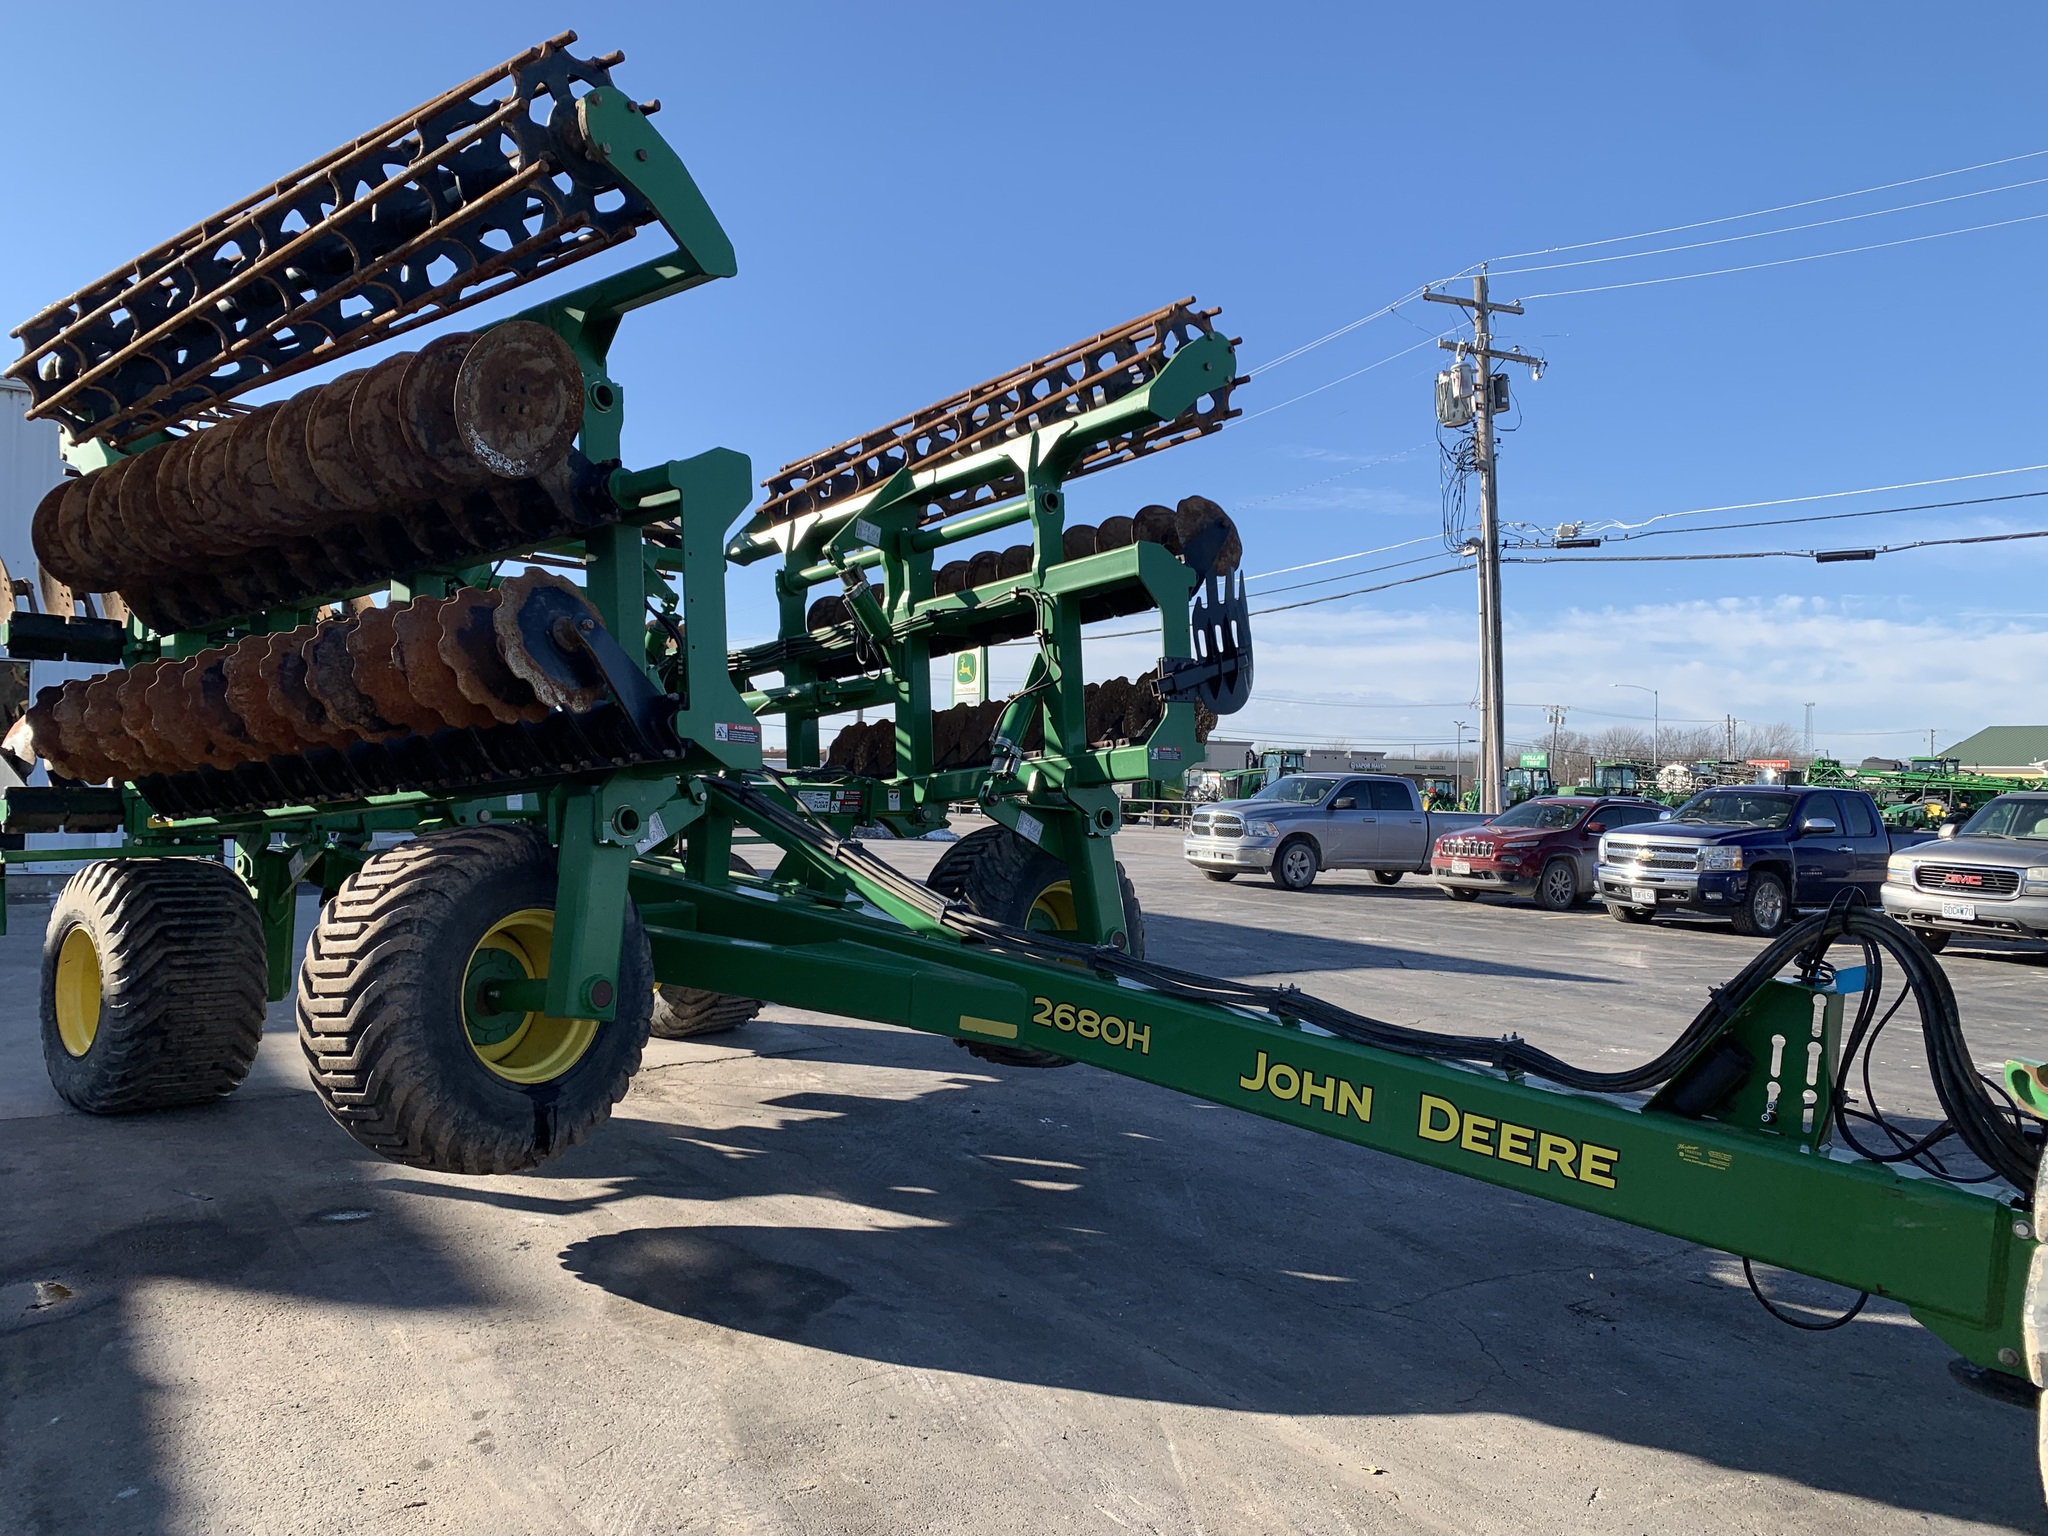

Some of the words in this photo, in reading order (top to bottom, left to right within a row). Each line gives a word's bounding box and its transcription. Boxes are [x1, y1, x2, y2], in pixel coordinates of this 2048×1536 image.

[1945, 873, 1982, 885] GMC
[1032, 996, 1151, 1054] 2680H
[1239, 1051, 1373, 1123] JOHN
[1418, 1094, 1619, 1189] DEERE
